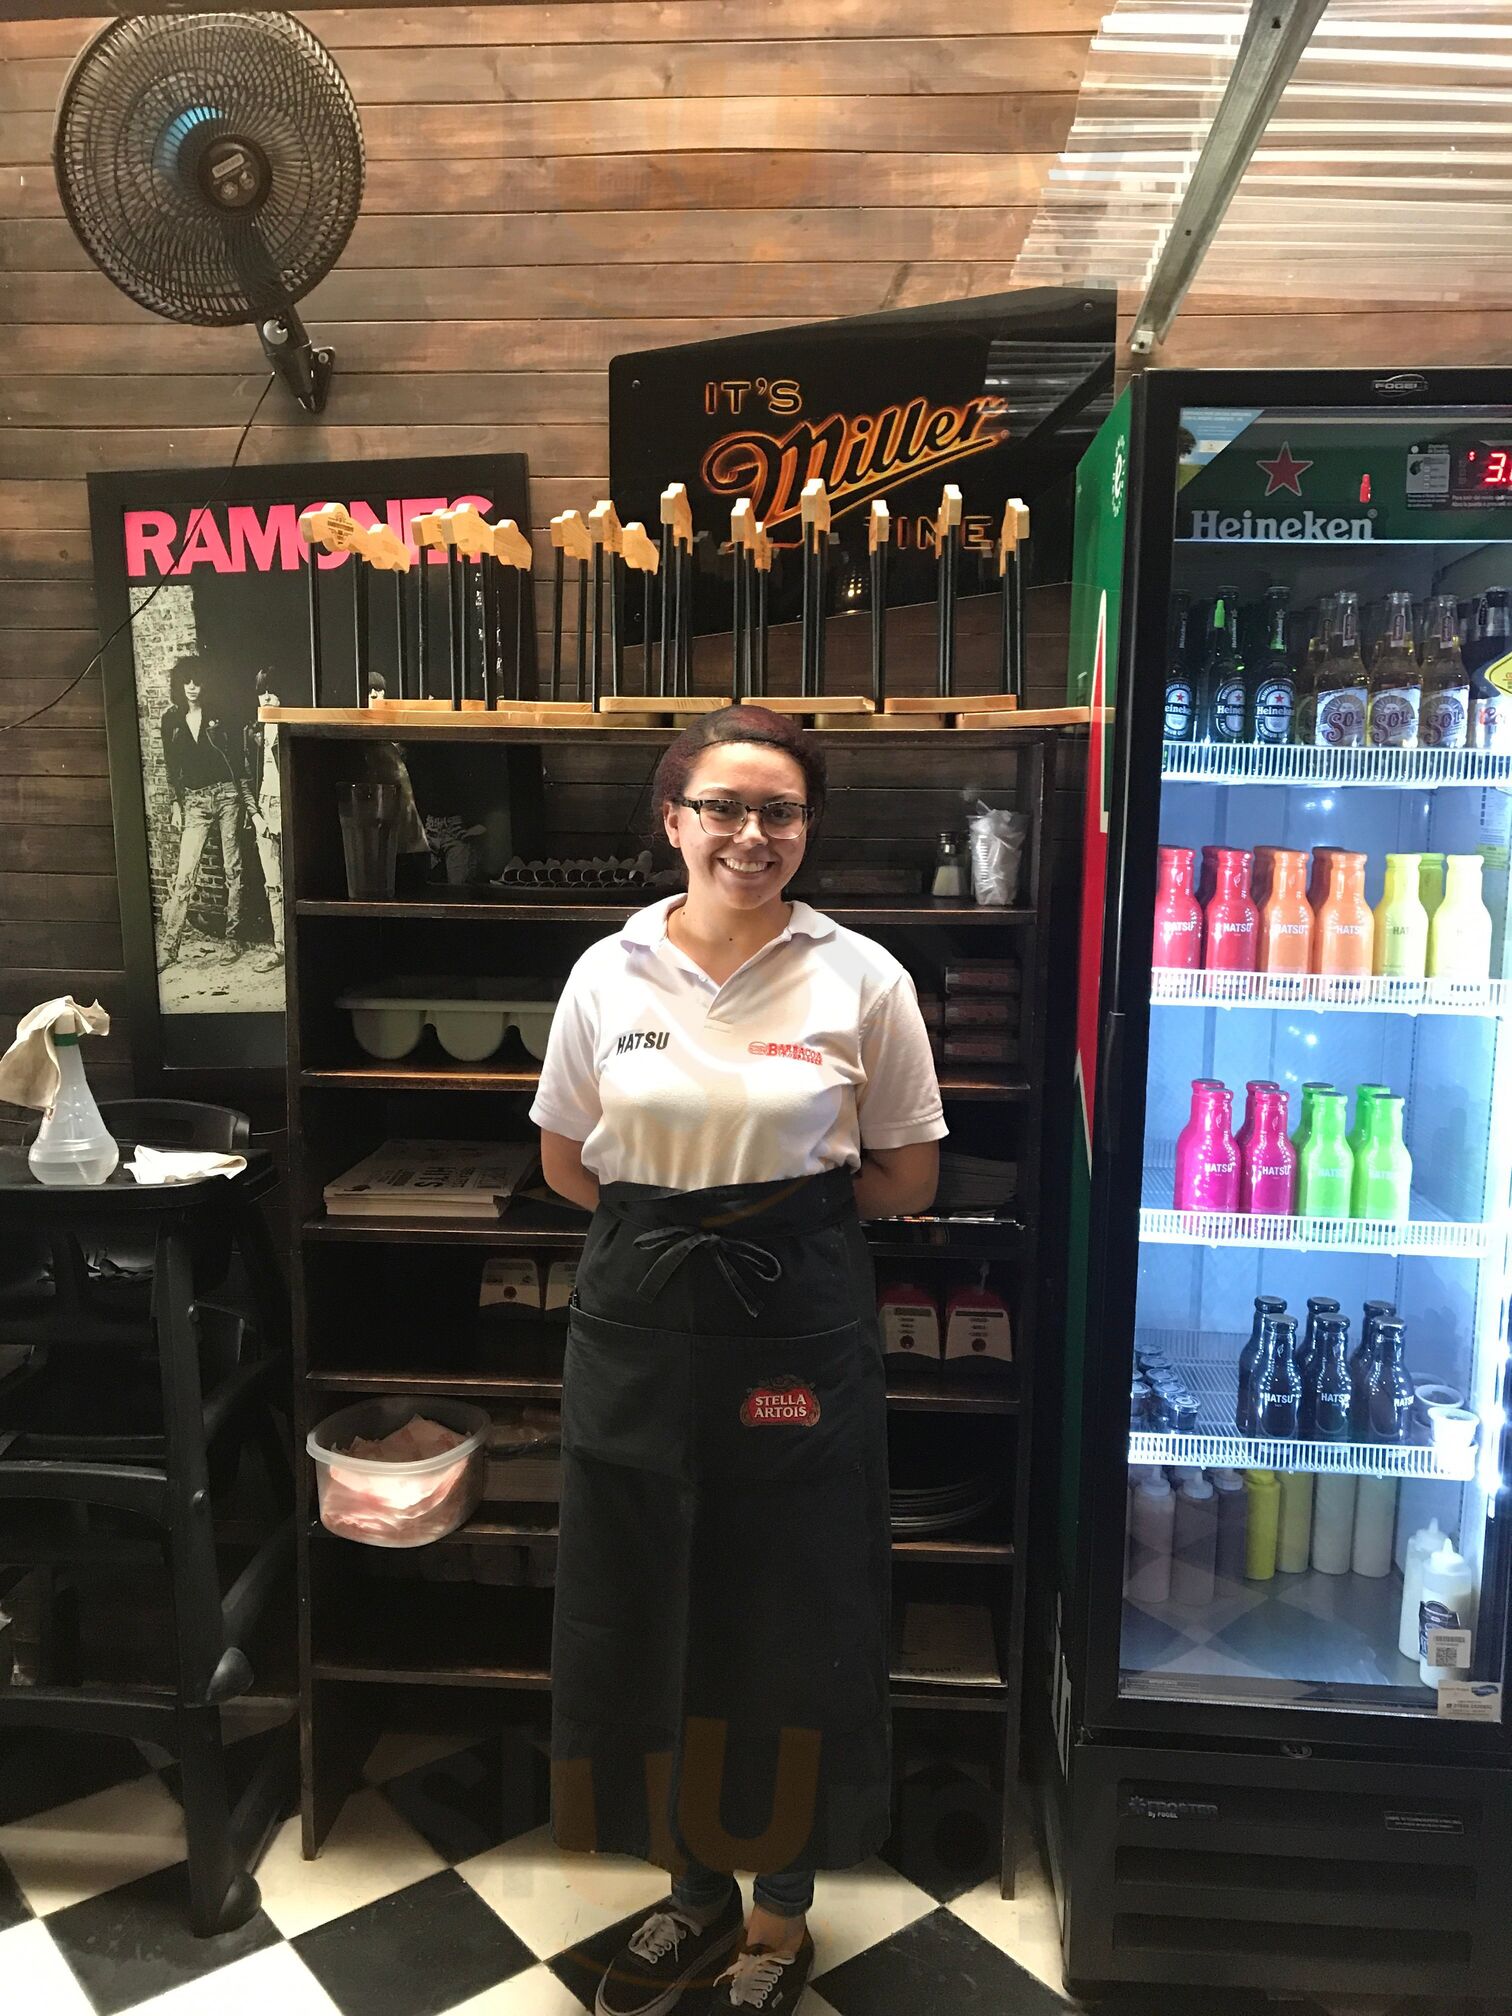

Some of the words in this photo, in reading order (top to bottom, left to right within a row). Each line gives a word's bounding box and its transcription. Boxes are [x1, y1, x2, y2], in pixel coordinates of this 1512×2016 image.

[705, 377, 803, 415] IT'S
[702, 396, 1006, 528] Miller
[1484, 452, 1512, 483] 3.
[1191, 509, 1375, 540] Heineken
[1371, 709, 1411, 743] SOL
[1424, 710, 1464, 744] SOL
[1223, 922, 1253, 933] HATSU
[617, 1031, 670, 1056] HATSU
[1262, 1165, 1291, 1176] HATSU
[754, 1406, 808, 1418] ARTOIS
[755, 1394, 807, 1406] STELLA
[1265, 1393, 1295, 1404] HATSU
